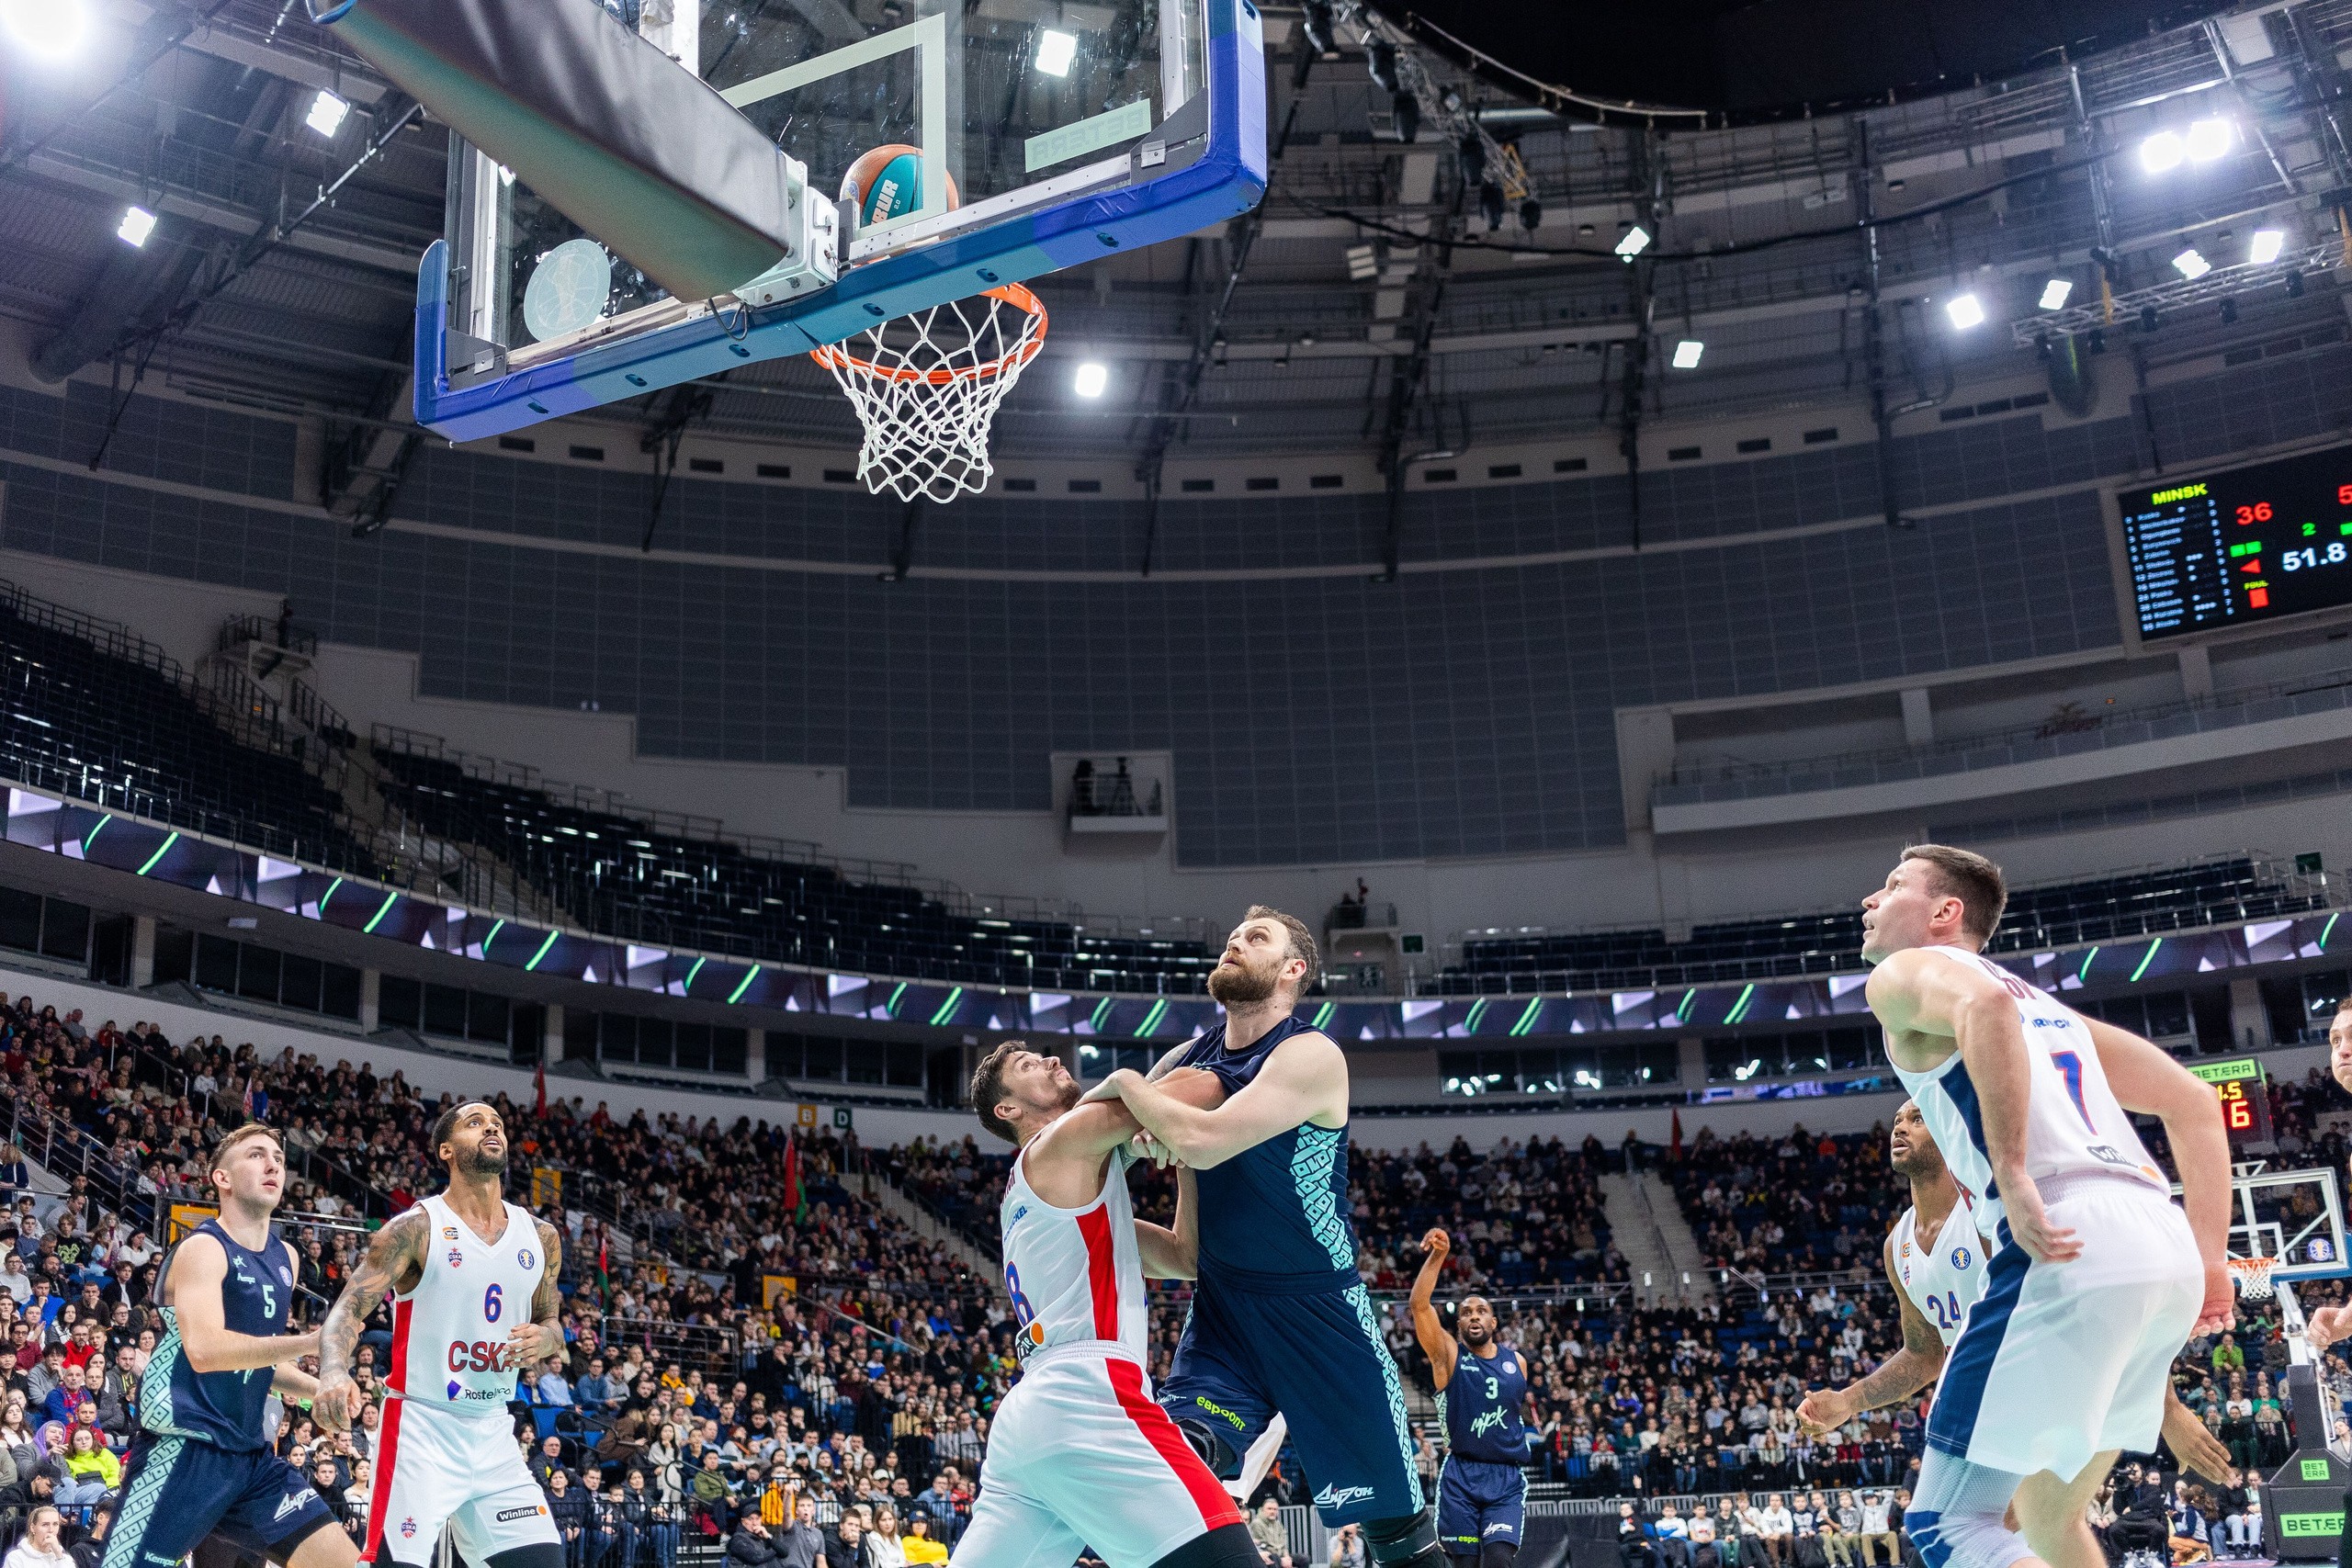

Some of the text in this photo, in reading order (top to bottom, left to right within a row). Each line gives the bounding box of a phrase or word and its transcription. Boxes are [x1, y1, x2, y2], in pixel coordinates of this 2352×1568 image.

[871, 179, 899, 226] BUR
[2152, 483, 2209, 505] MINSK
[2235, 502, 2274, 525] 36
[2301, 523, 2317, 536] 2
[2282, 542, 2347, 571] 51.8
[2050, 1050, 2098, 1136] 7
[837, 1111, 849, 1126] D
[2230, 1100, 2251, 1130] 6
[262, 1284, 277, 1319] 5
[484, 1282, 503, 1324] 6
[1927, 1291, 1962, 1329] 24
[1485, 1377, 1498, 1400] 3
[499, 1507, 536, 1521] Winline
[143, 1551, 175, 1567] Kempa
